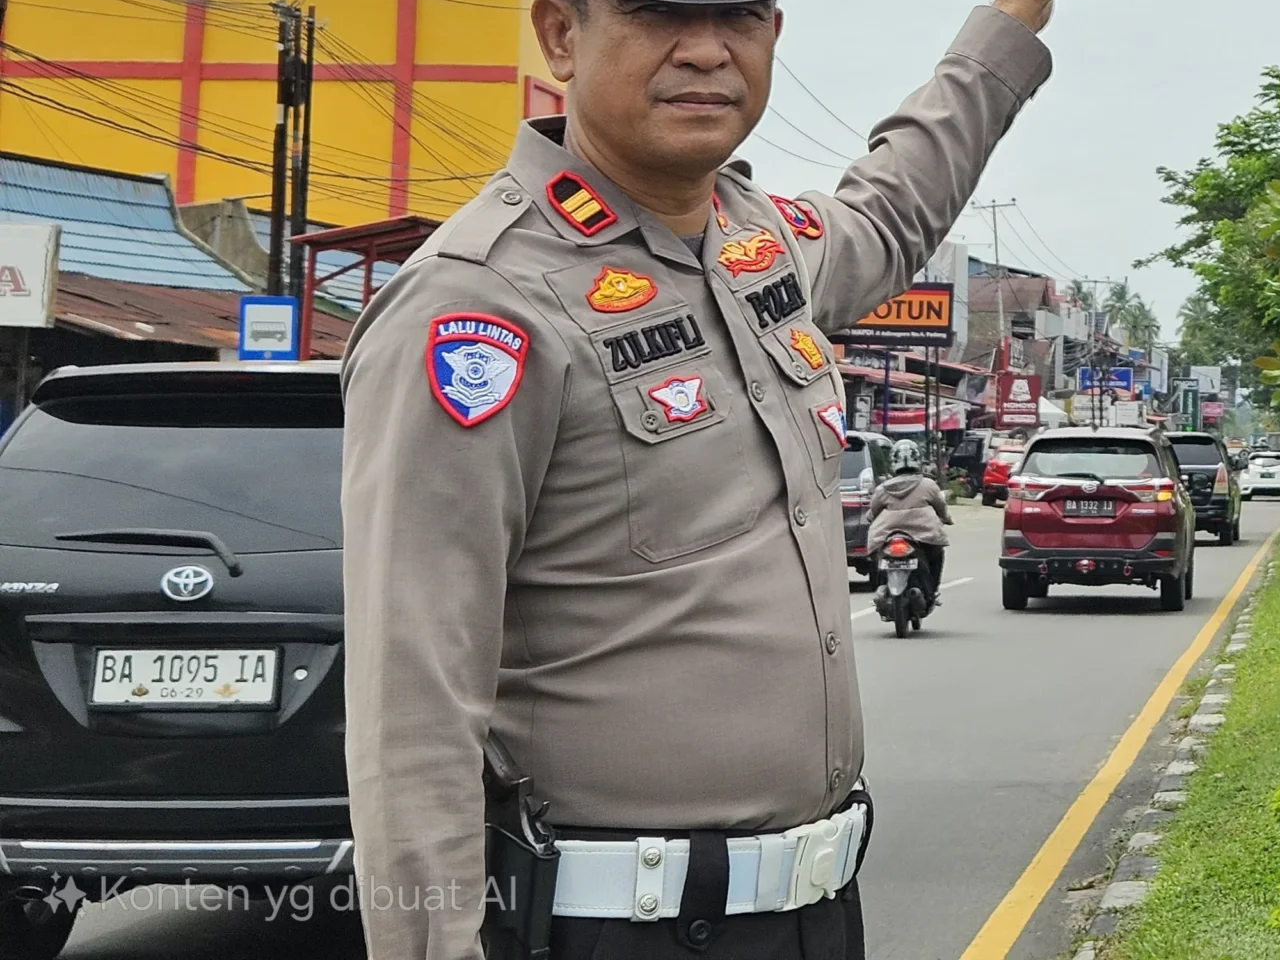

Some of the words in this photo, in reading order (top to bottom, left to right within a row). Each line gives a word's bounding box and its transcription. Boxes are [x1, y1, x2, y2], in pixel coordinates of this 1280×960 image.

[745, 272, 807, 329] POLRI
[872, 300, 943, 320] OTUN
[438, 321, 475, 336] LALU
[478, 322, 522, 350] LINTAS
[603, 314, 706, 372] ZULKIFLI
[1066, 500, 1077, 510] BA
[1080, 500, 1098, 510] 1332
[101, 654, 133, 683] BA
[151, 654, 219, 683] 1095
[235, 654, 267, 683] IA
